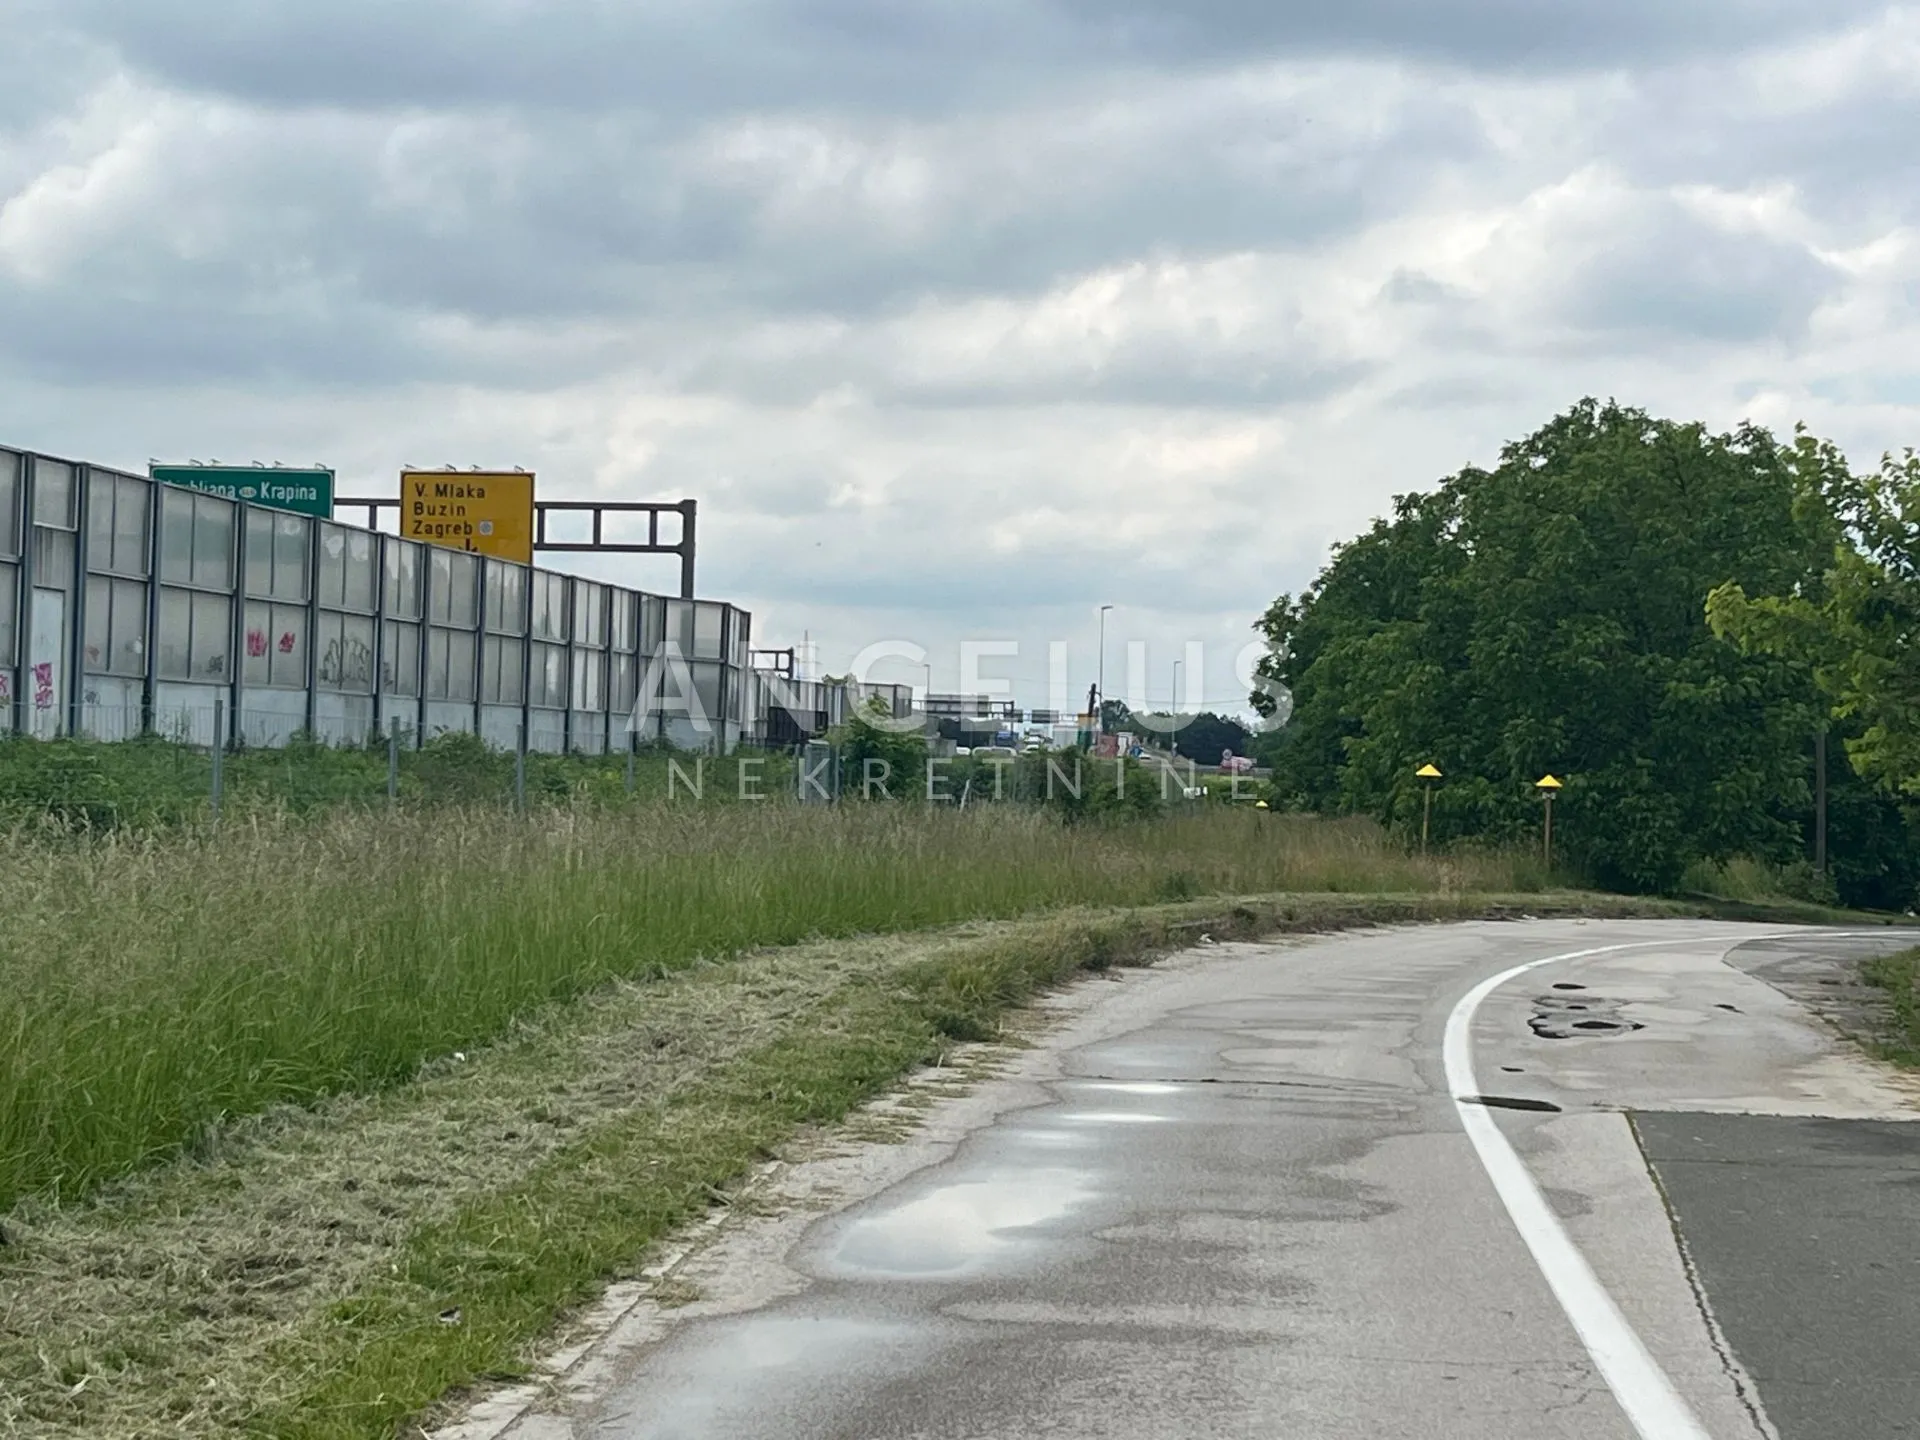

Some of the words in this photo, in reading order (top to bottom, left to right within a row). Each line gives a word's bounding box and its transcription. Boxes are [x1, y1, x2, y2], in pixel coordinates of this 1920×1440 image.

[260, 481, 317, 503] Krapina
[414, 482, 428, 497] V.
[435, 483, 486, 498] Mlaka
[413, 501, 466, 516] Buzin
[413, 519, 473, 538] Zagreb
